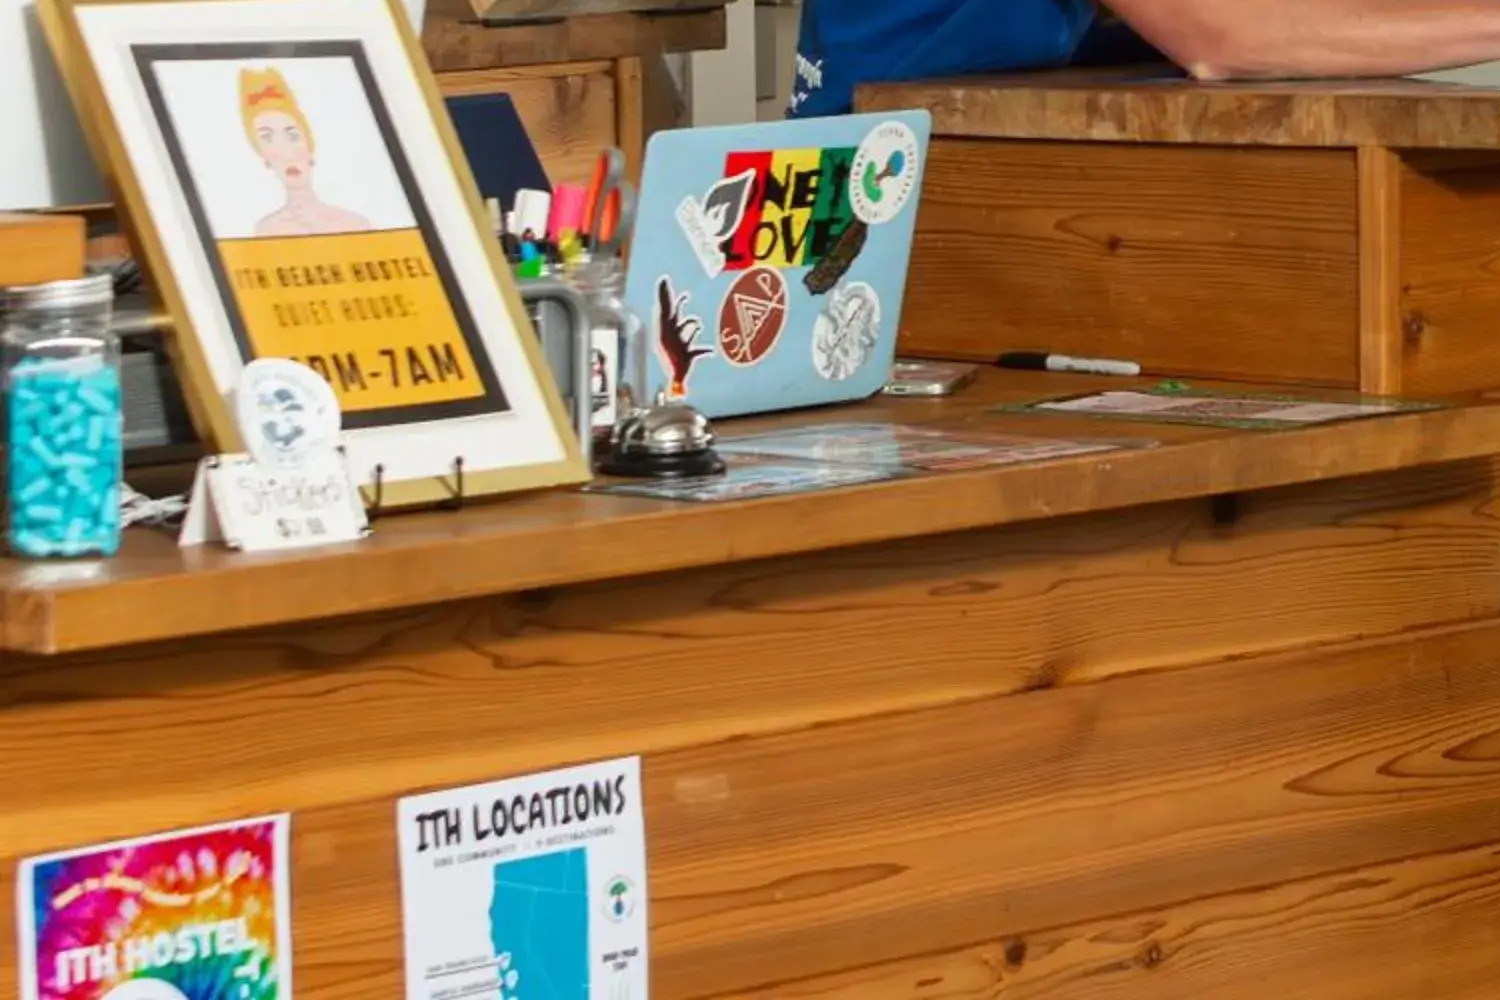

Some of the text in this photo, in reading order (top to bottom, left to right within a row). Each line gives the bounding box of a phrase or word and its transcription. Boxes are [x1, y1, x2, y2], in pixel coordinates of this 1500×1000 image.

[274, 262, 346, 288] BEACH
[351, 256, 432, 284] HOSTEL
[272, 298, 337, 329] QUIET
[289, 342, 465, 394] PM-7AM
[415, 774, 627, 853] ITH LOCATIONS
[55, 916, 258, 994] ITH HOSTEL
